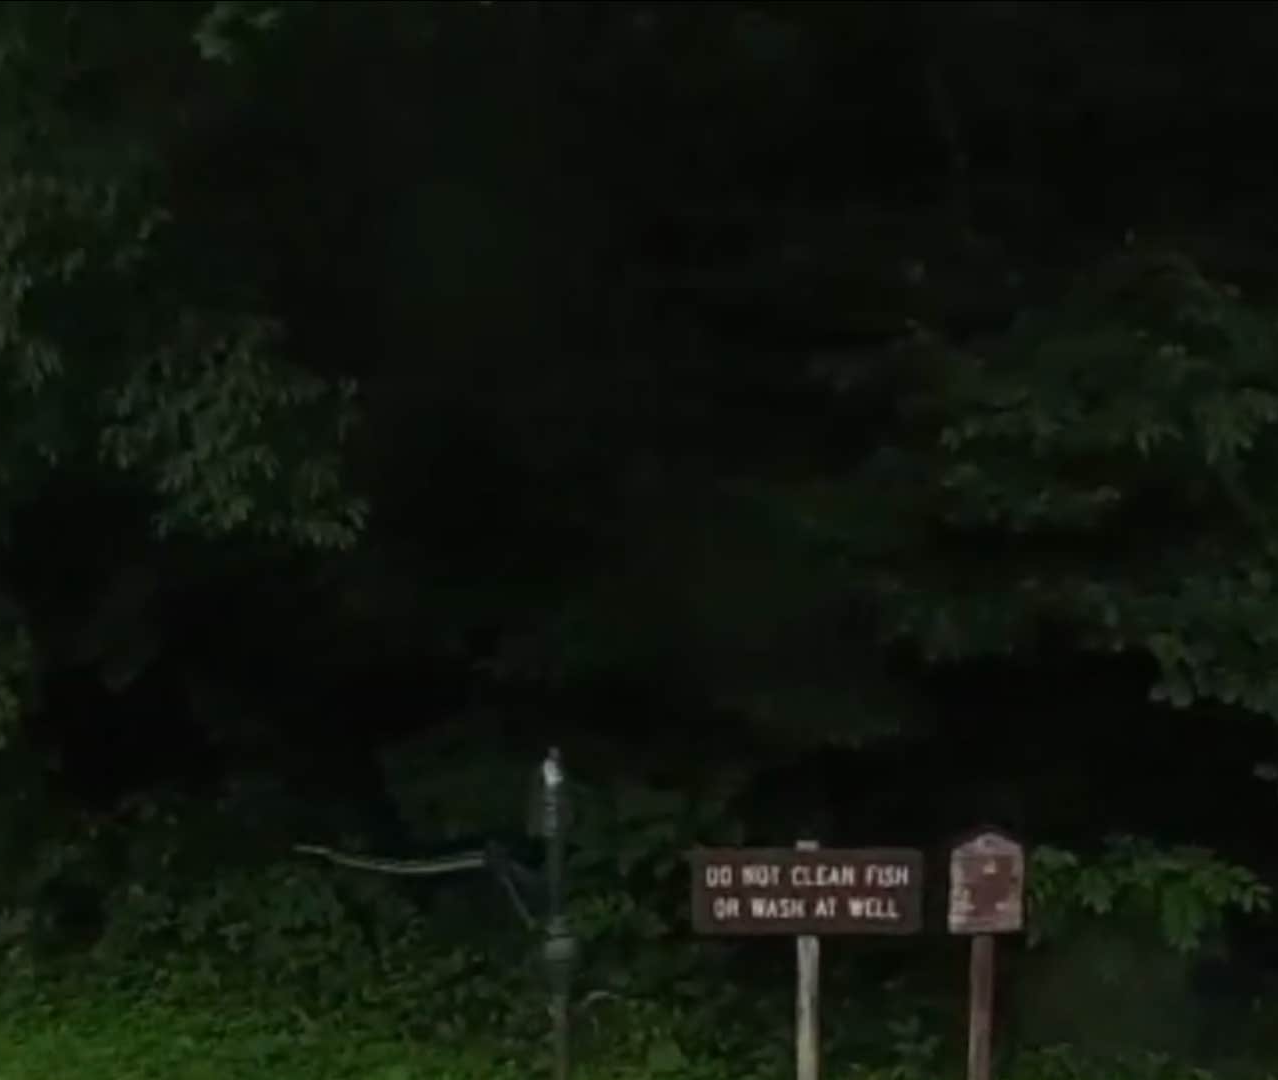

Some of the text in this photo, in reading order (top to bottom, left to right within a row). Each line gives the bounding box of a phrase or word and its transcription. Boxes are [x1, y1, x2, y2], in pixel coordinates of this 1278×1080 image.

[705, 865, 909, 887] DO NOT CLEAN FISH
[713, 898, 900, 919] OR WASH AT WELL
